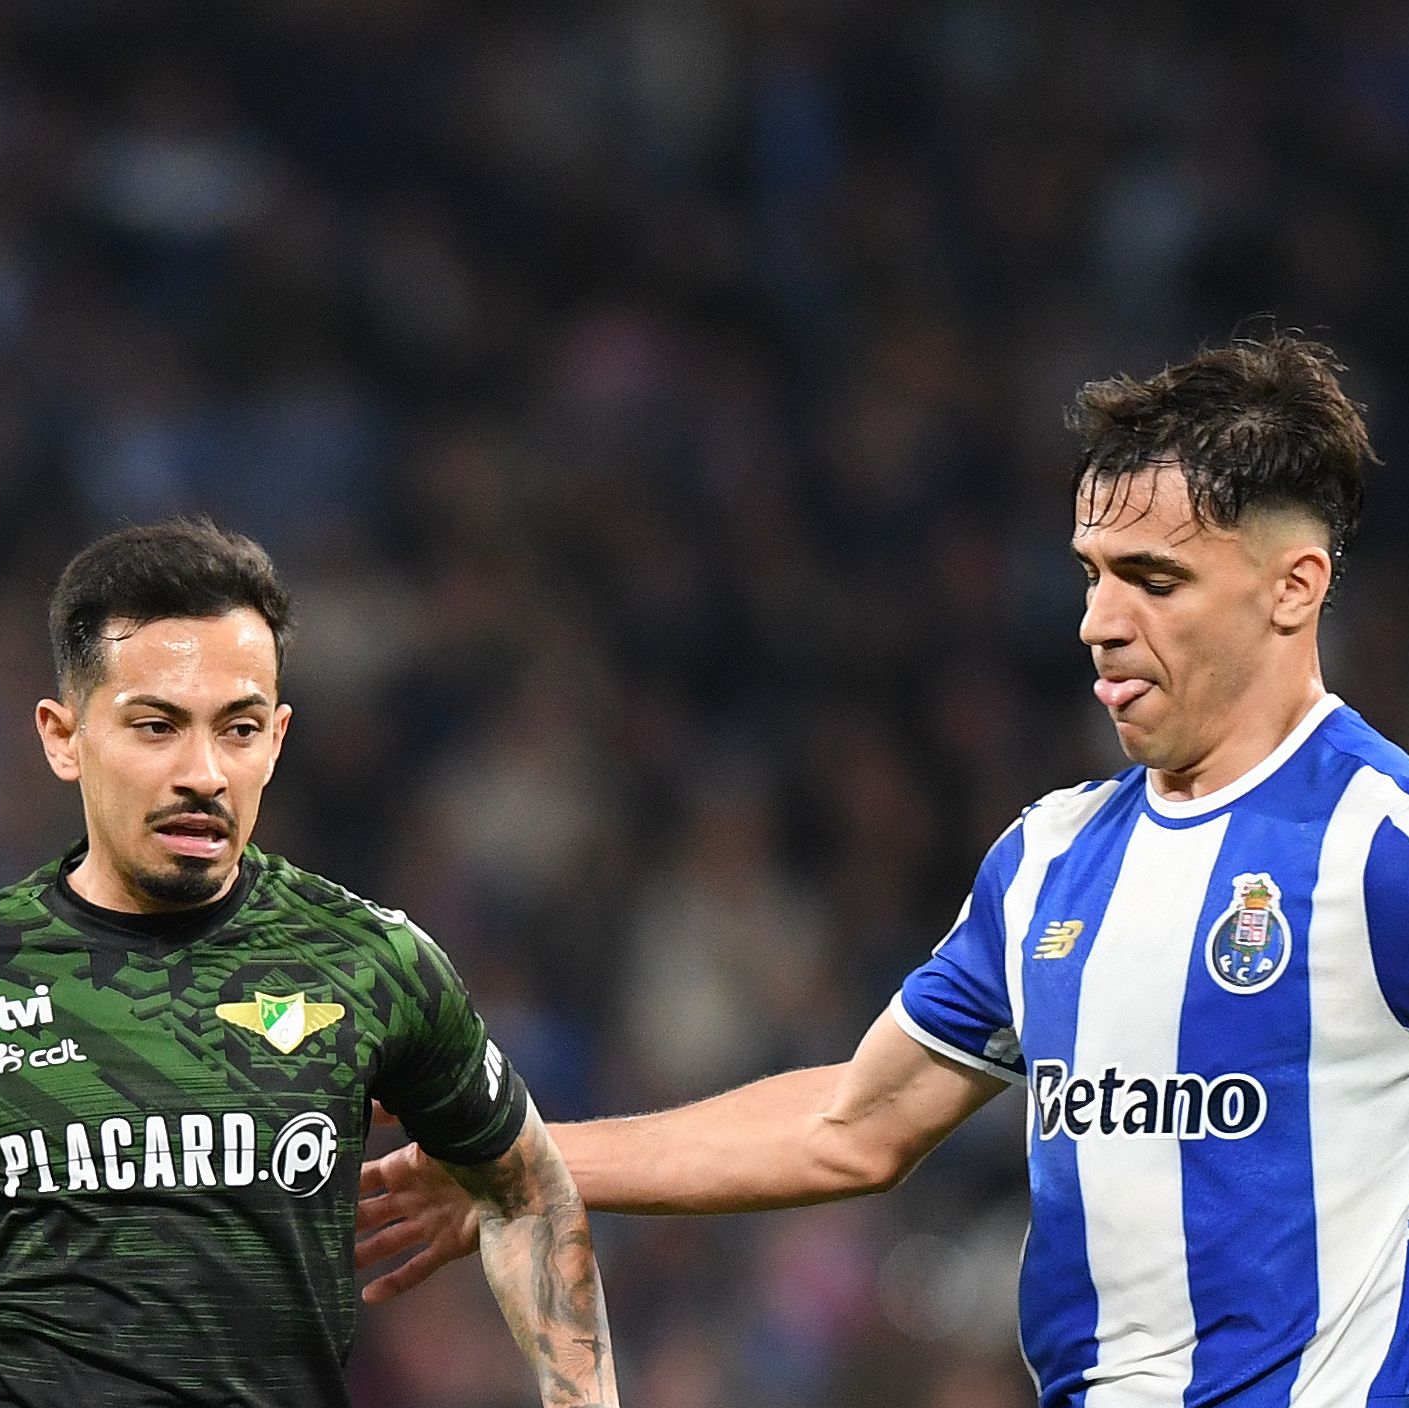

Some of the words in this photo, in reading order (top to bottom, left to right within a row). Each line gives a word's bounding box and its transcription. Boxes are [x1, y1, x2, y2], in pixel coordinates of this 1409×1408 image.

[1219, 955, 1273, 980] FCP
[29, 1038, 87, 1068] cdt
[1035, 1060, 1264, 1138] Betano
